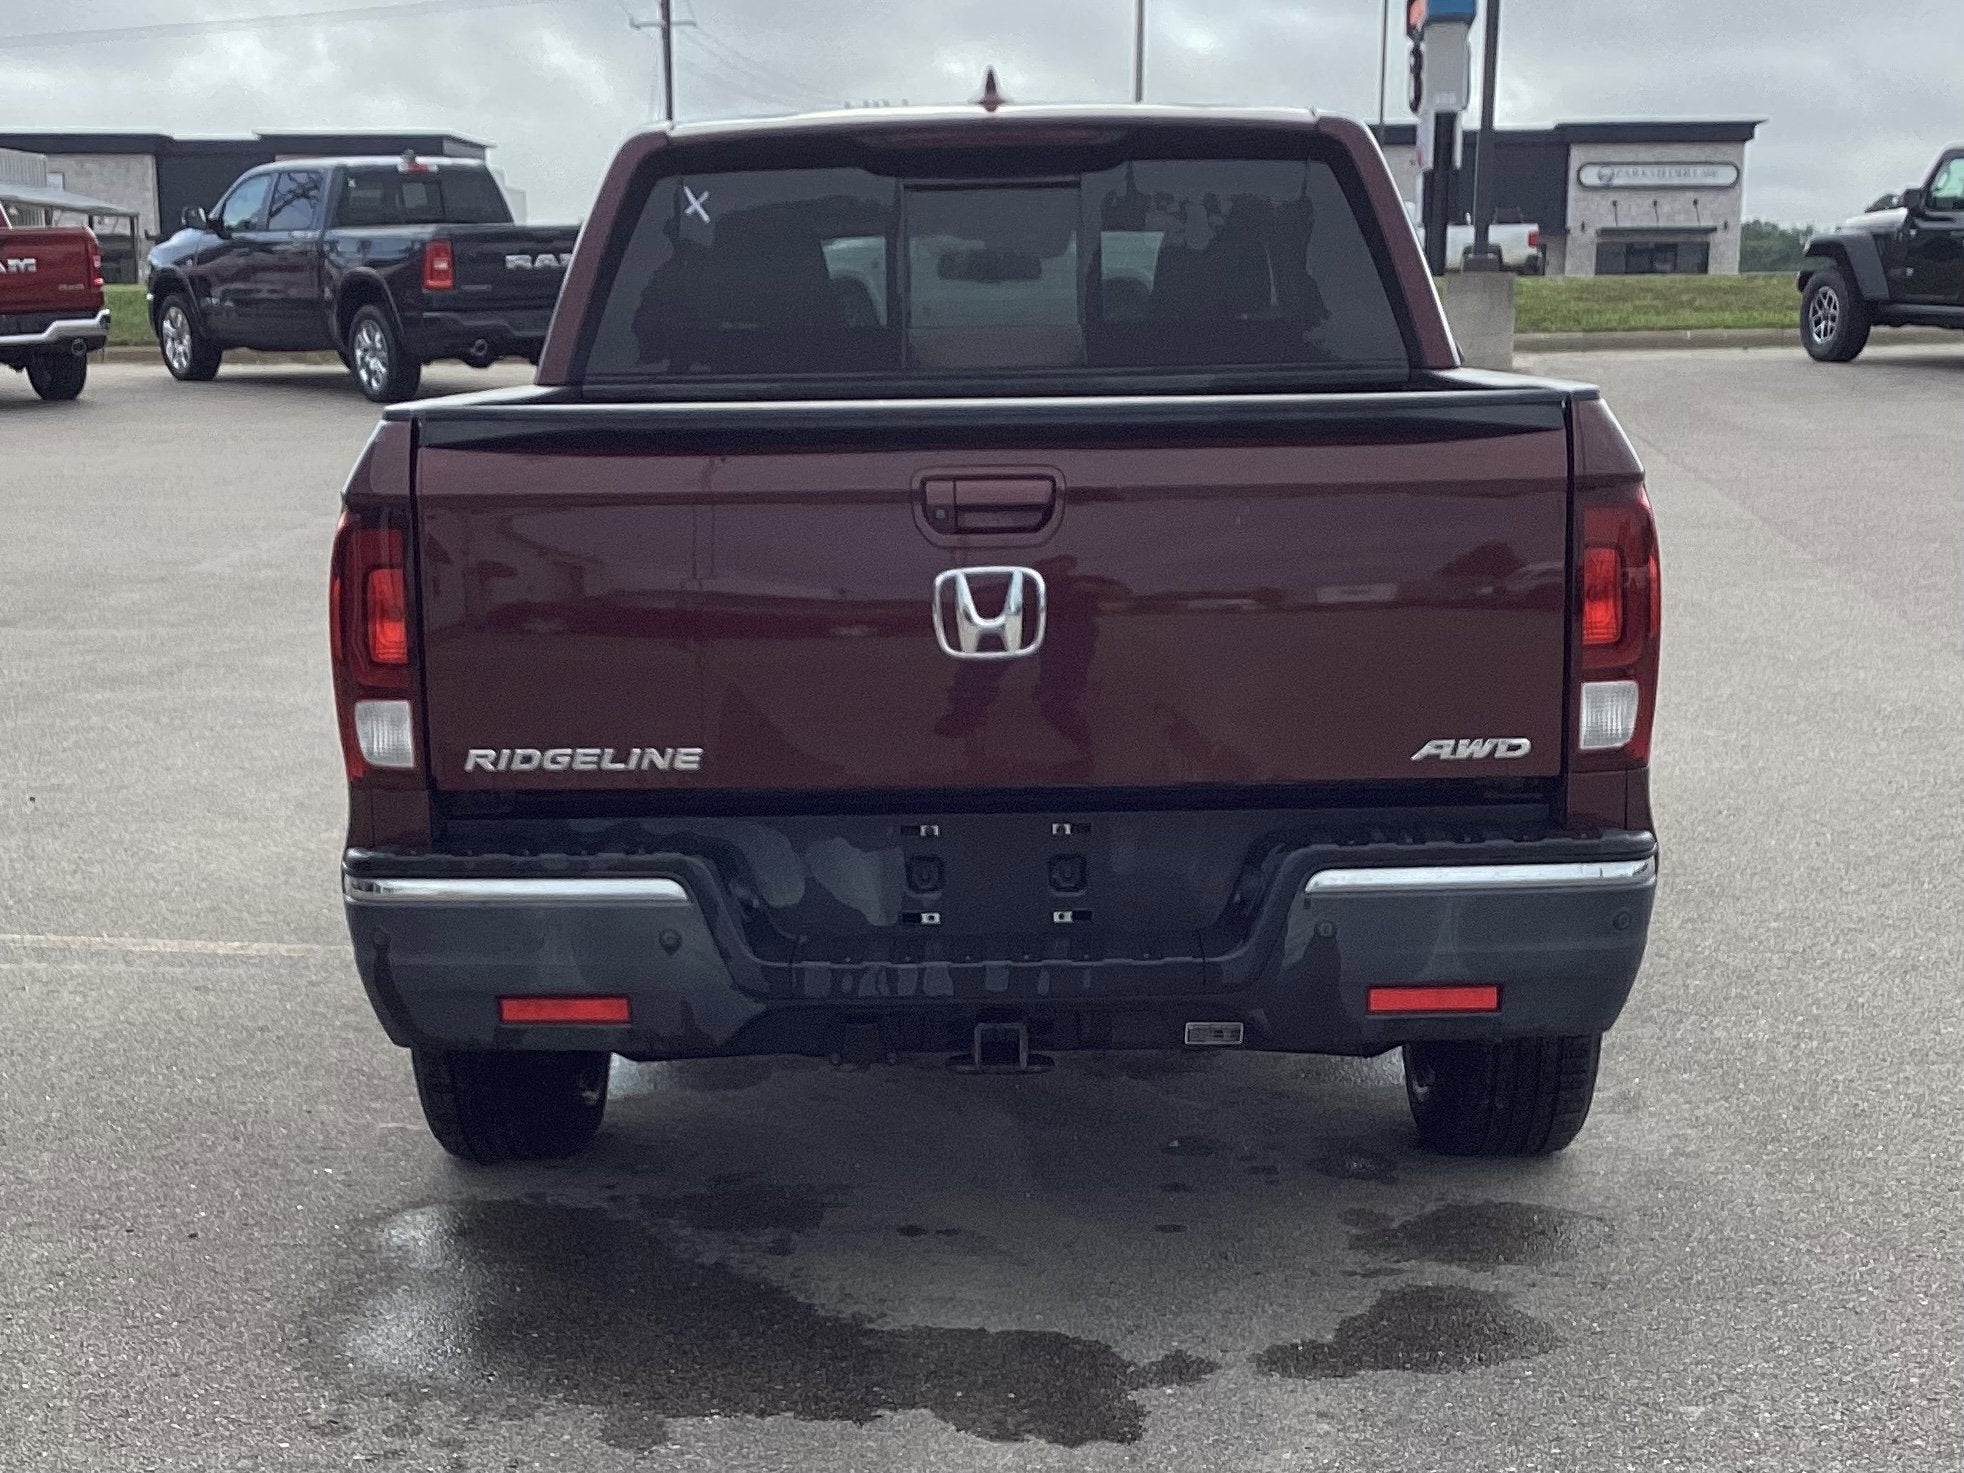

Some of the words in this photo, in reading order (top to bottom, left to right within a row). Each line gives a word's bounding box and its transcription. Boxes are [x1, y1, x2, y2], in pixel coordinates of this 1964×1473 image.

[0, 258, 37, 274] M
[464, 747, 703, 772] RIDGELINE
[1410, 738, 1532, 760] AWD
